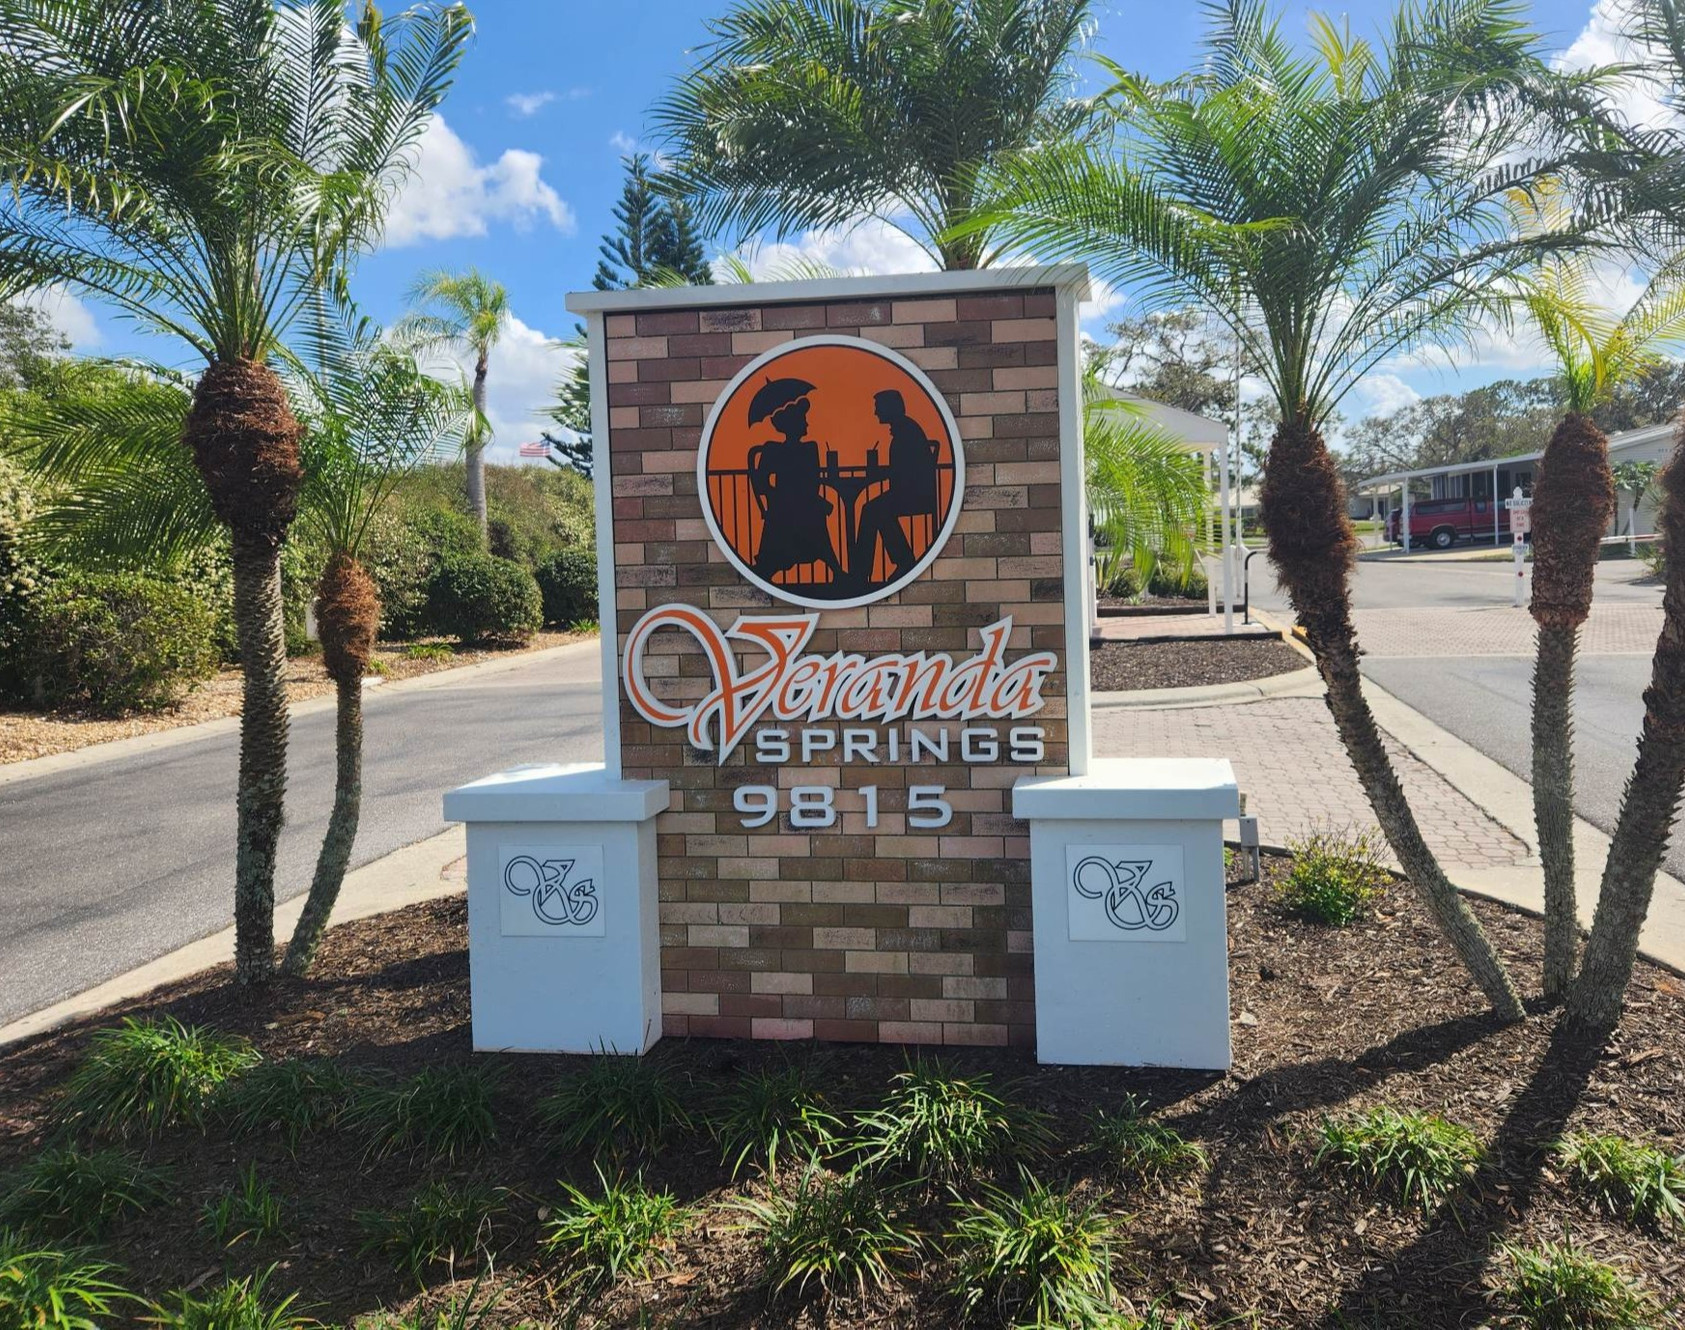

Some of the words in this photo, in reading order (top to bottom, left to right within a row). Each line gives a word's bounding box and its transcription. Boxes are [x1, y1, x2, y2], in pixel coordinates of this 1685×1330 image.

[623, 603, 1058, 766] Veranda
[755, 727, 1046, 764] SPRINGS
[732, 784, 954, 829] 9815
